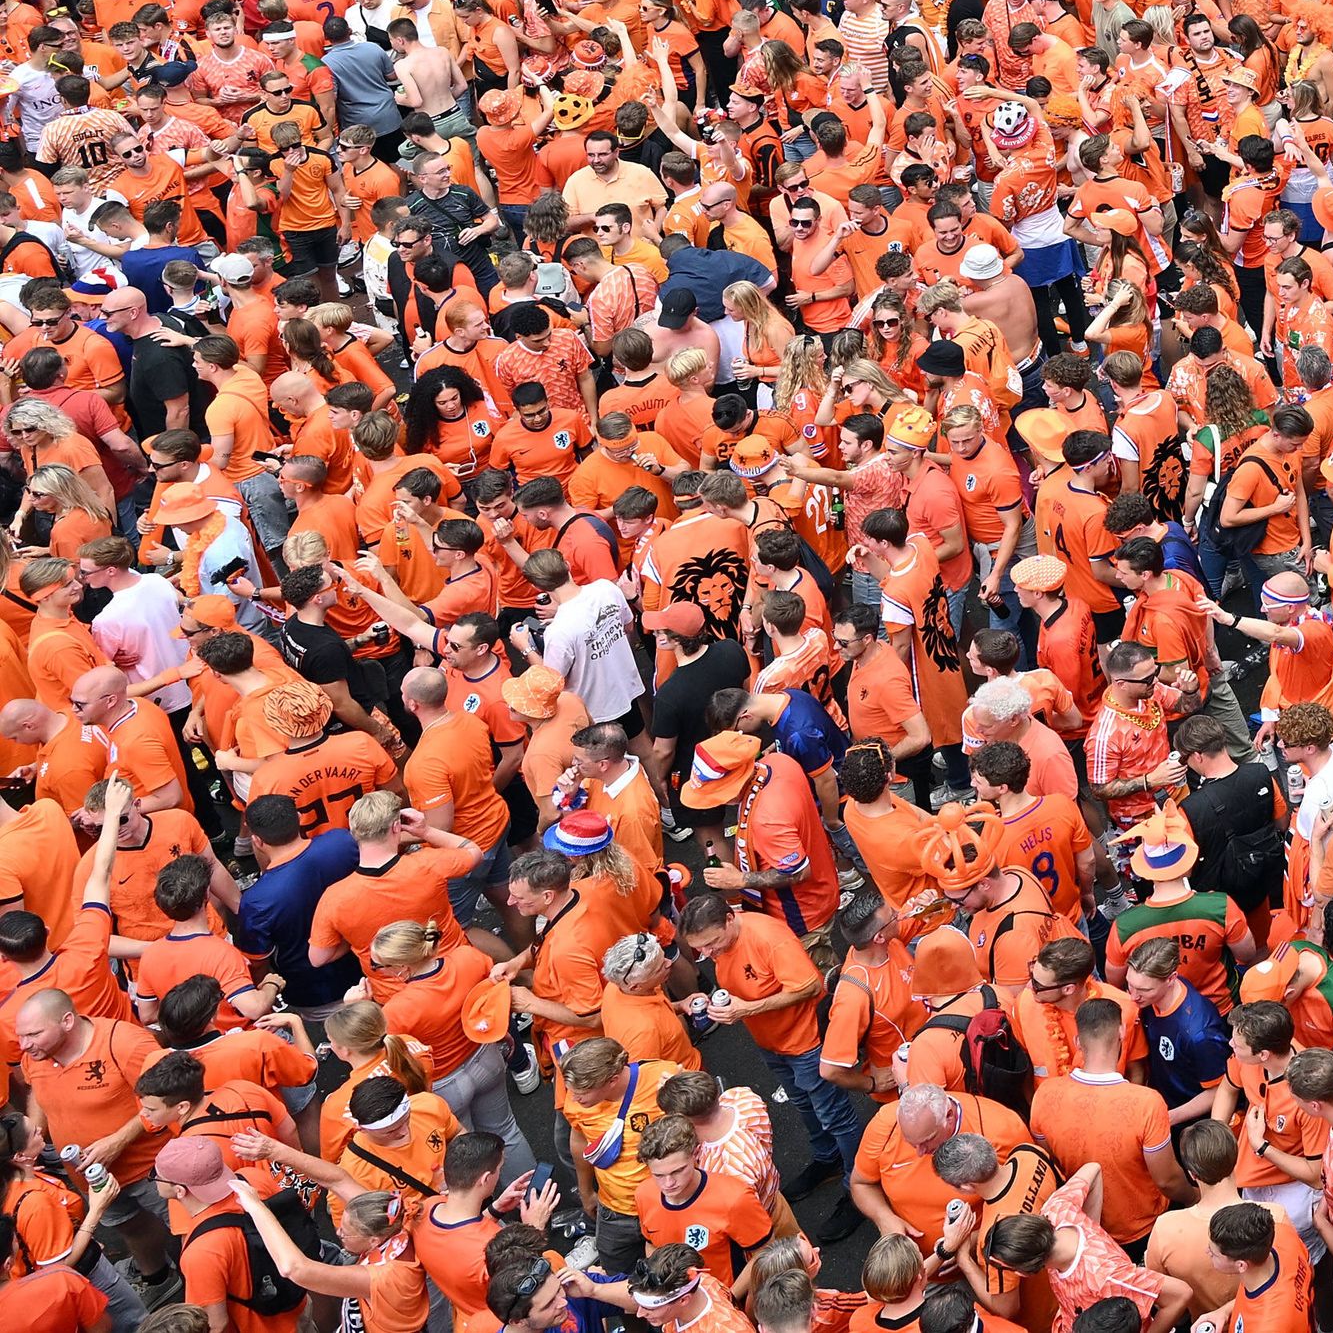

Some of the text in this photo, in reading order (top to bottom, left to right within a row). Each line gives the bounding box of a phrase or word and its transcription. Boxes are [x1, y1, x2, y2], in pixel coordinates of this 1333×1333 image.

[33, 96, 62, 110] ING
[72, 129, 104, 143] GULLIT
[77, 141, 107, 168] 10
[145, 180, 182, 207] TOPLINE
[624, 399, 670, 417] ANJUMA
[795, 393, 806, 410] 9
[1054, 523, 1075, 564] 4
[299, 766, 363, 788] DER VAART
[1019, 827, 1053, 855] HEIJS
[1030, 850, 1062, 895] 8
